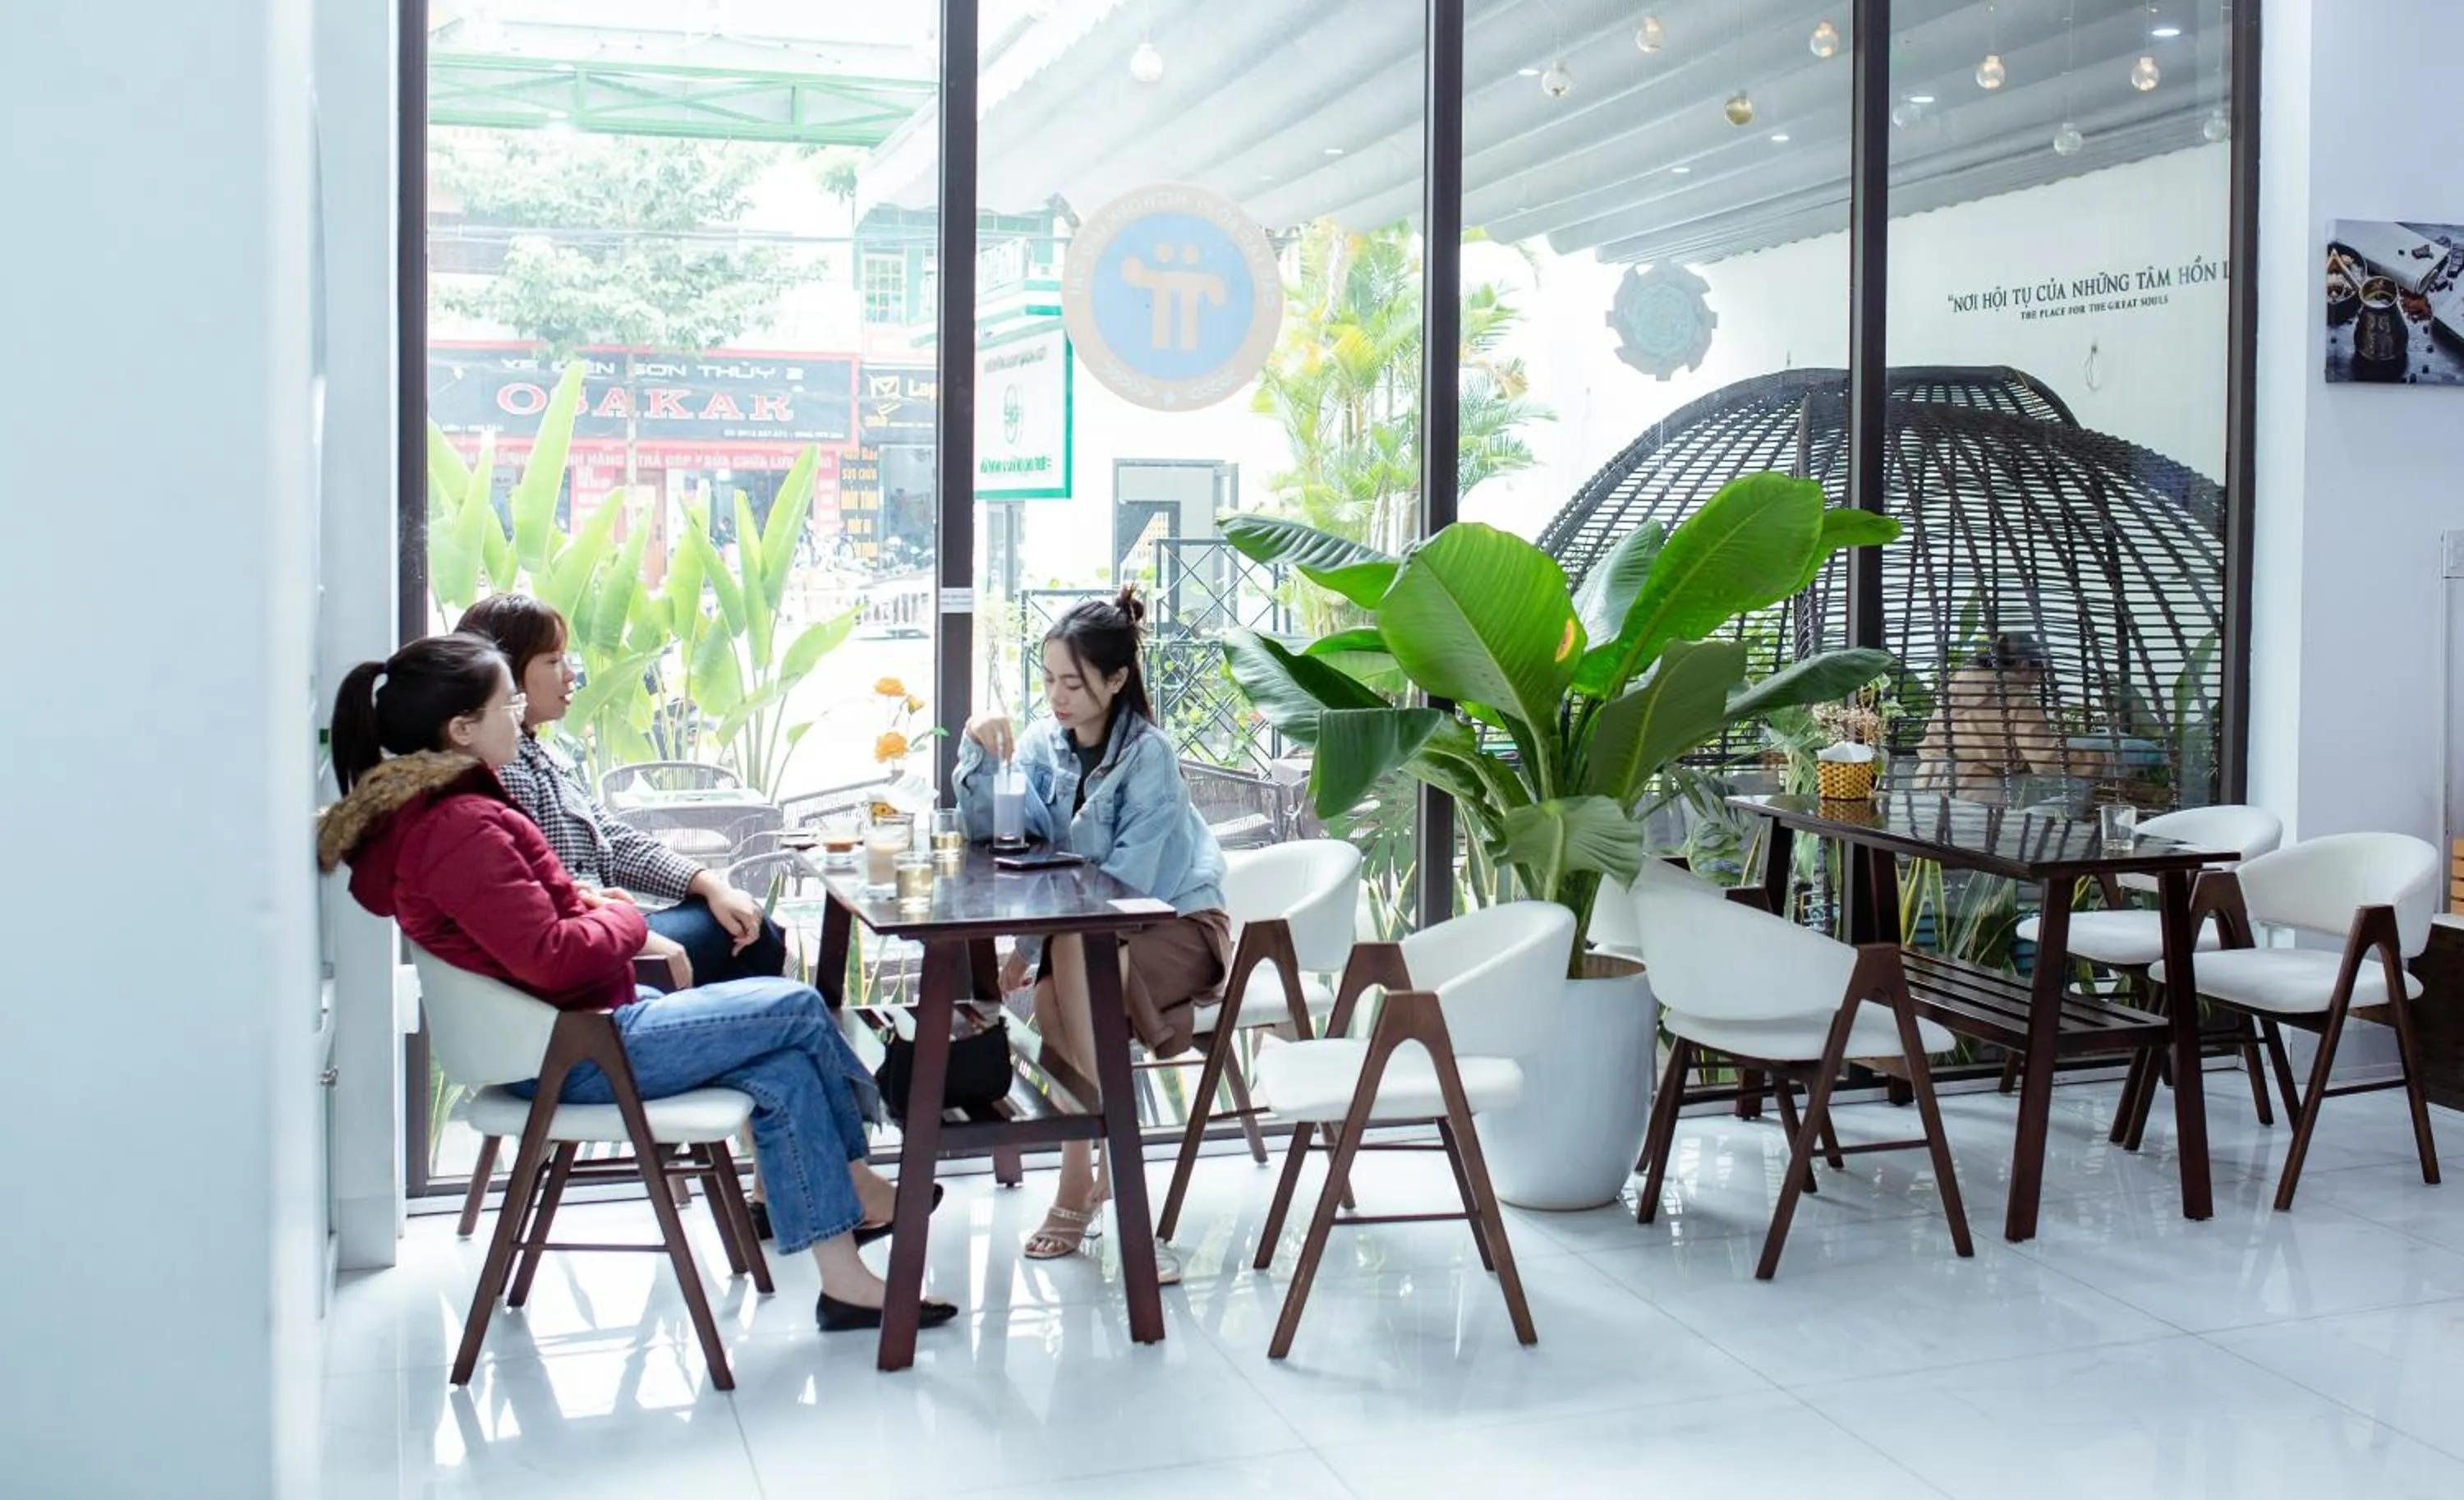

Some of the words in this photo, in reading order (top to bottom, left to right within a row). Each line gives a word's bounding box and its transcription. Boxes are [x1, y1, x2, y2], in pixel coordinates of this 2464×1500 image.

[1983, 286, 2007, 312] HỘI
[2012, 288, 2032, 308] TỤ
[2036, 278, 2066, 301] CỦA
[2071, 271, 2130, 297] NHỮNG
[2136, 265, 2172, 290] TÂM
[2021, 310, 2037, 320] THE
[2039, 306, 2066, 319] PLACE
[2068, 304, 2085, 315] FOR
[2089, 302, 2106, 313] THE
[2108, 298, 2137, 311] GREAT
[2140, 294, 2168, 306] SOULS
